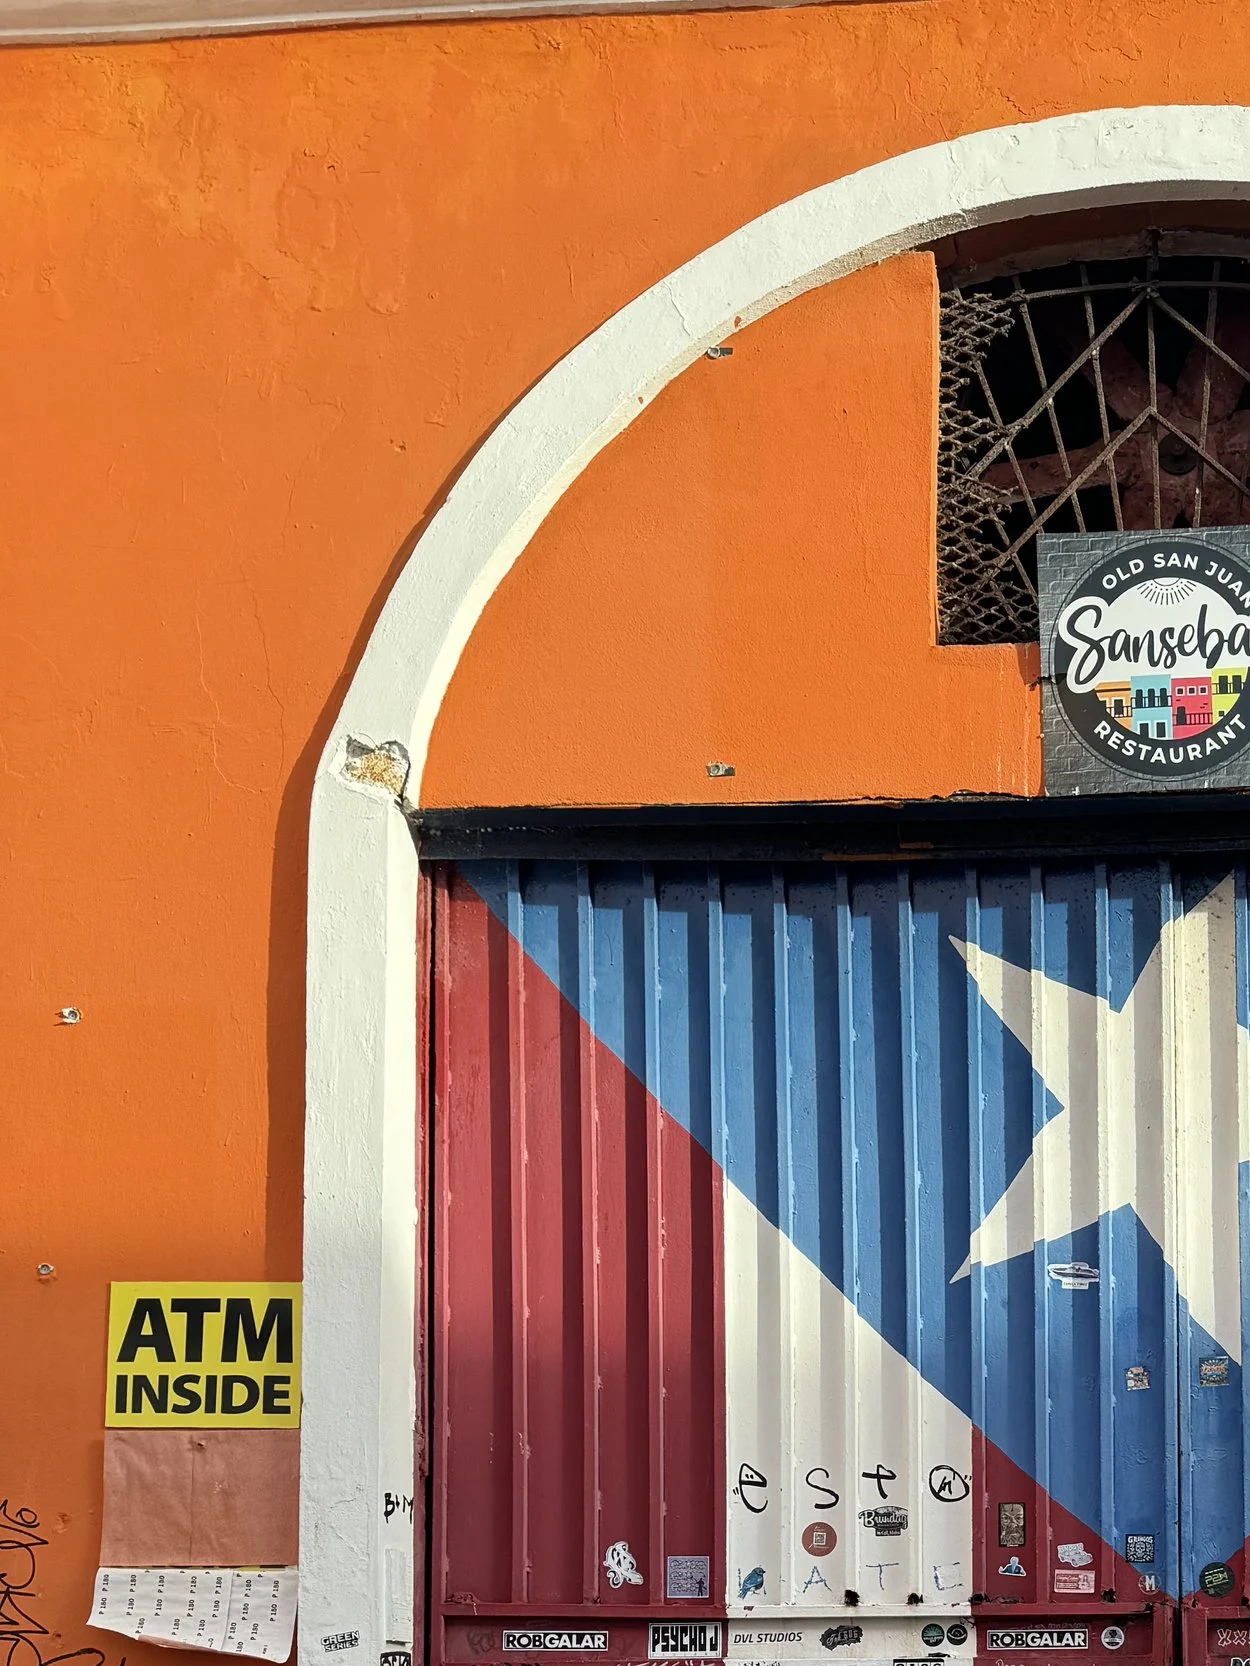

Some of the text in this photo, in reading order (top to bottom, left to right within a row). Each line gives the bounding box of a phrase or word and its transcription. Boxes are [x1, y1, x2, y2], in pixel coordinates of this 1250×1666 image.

[1102, 556, 1146, 591] OLD
[1153, 551, 1200, 572] SAN
[1093, 712, 1248, 765] RESTAURANT
[116, 1297, 294, 1364] ATM
[115, 1374, 292, 1416] INSIDE
[321, 1630, 360, 1646] GREEN
[324, 1640, 360, 1653] SERIES
[734, 1632, 803, 1644] DVL STUDIOS
